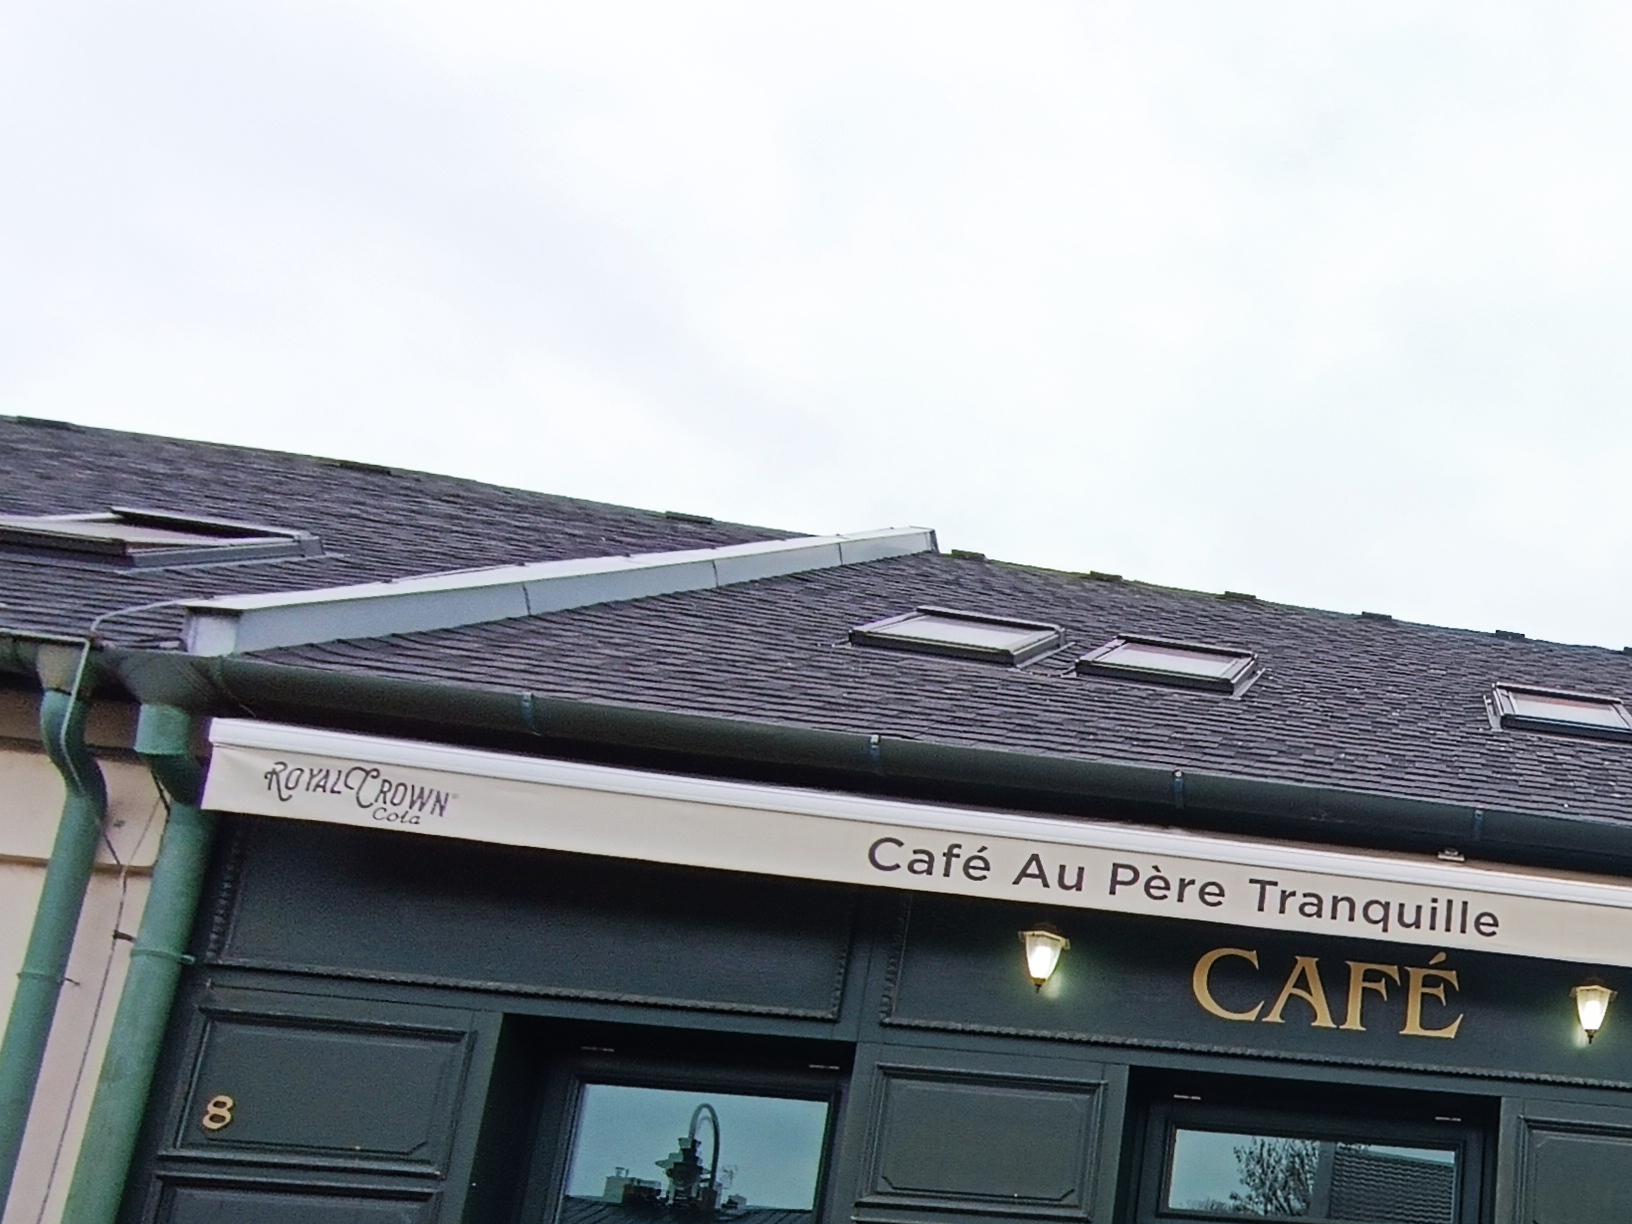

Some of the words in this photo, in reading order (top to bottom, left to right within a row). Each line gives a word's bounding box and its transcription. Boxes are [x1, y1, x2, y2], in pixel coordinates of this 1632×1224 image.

[344, 766, 450, 818] CROWN
[371, 807, 421, 825] Cola
[866, 835, 991, 882] Café
[1012, 852, 1086, 894] Au
[1108, 861, 1227, 909] Père
[1248, 877, 1501, 939] Tranquille
[1192, 948, 1464, 1040] CAFÉ
[202, 1095, 234, 1130] 8
